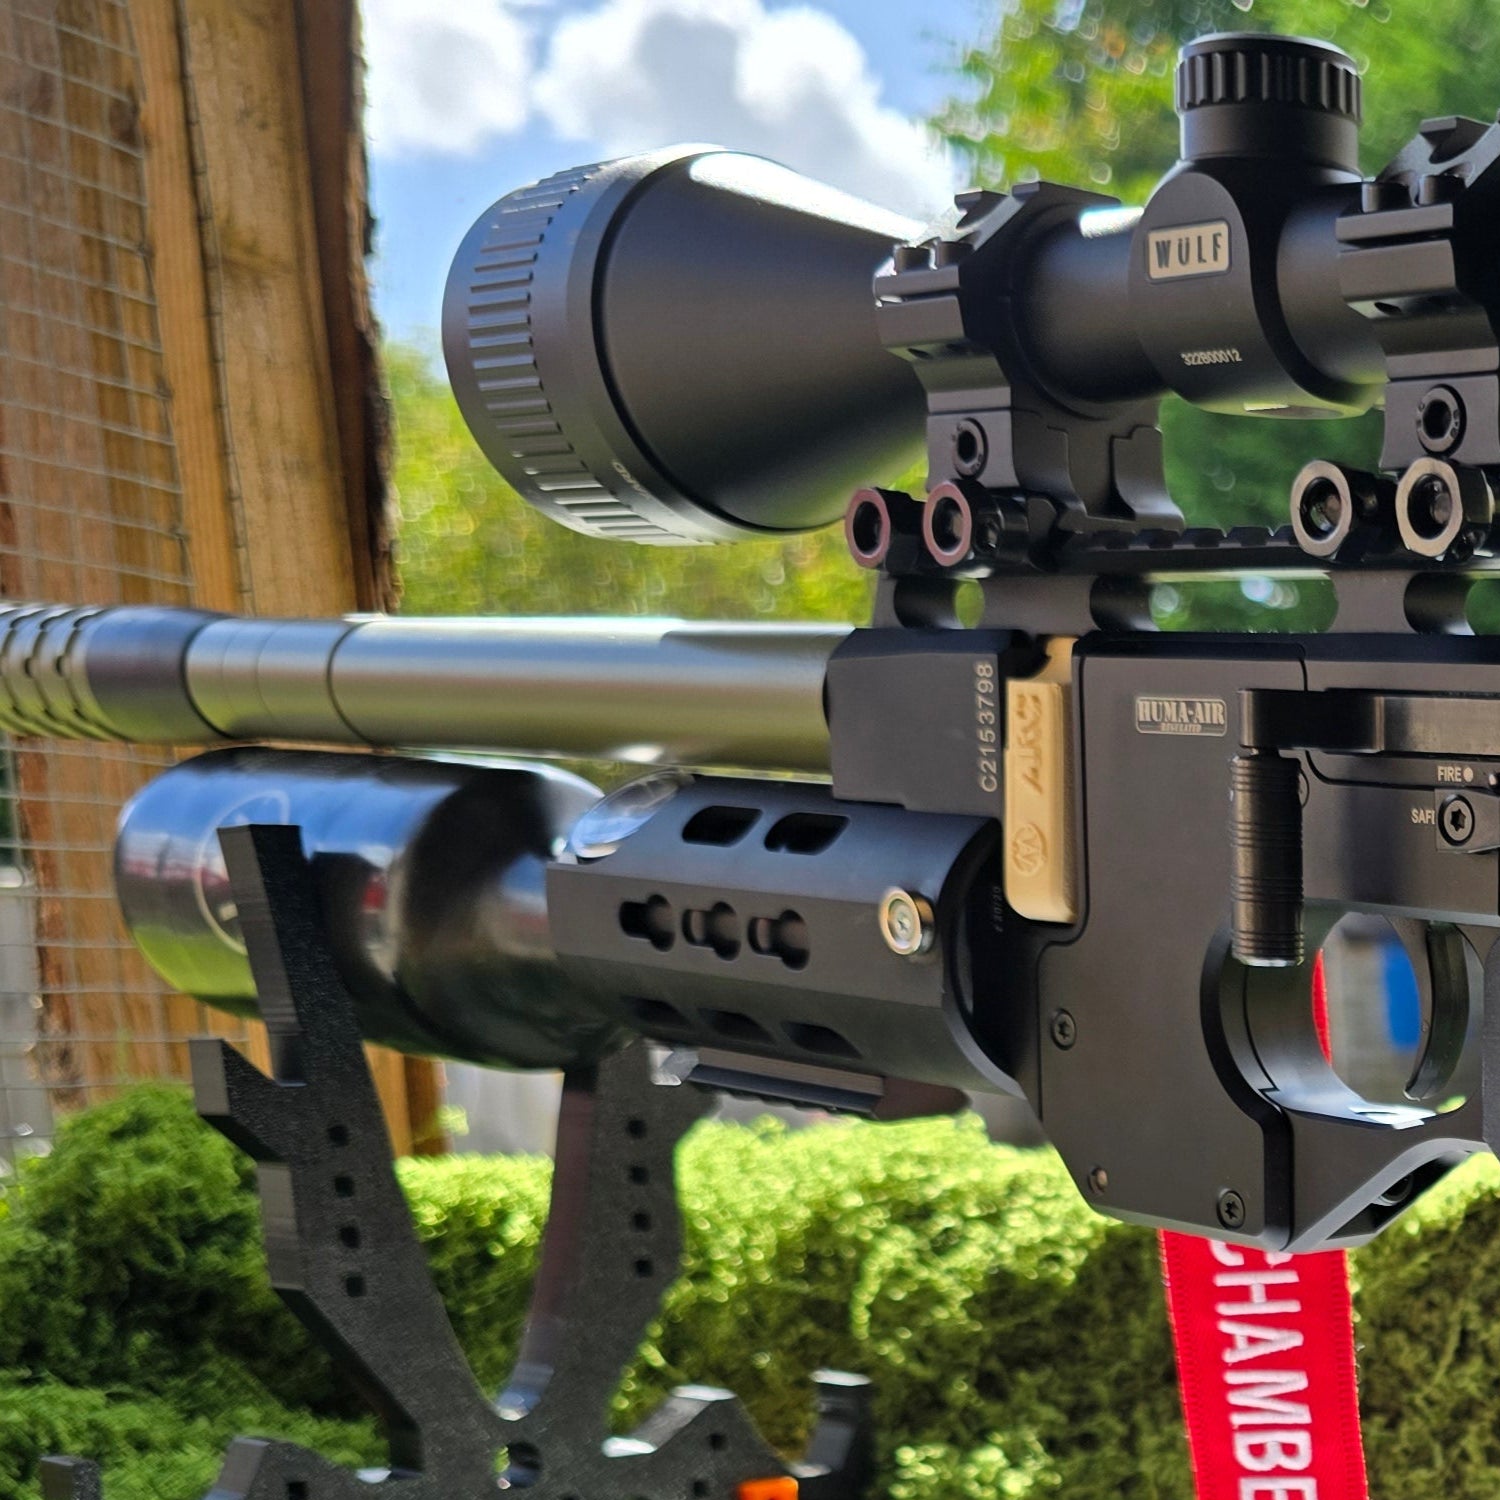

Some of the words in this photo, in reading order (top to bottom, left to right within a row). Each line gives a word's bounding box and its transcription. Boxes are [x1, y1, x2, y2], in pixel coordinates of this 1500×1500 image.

[1155, 232, 1222, 269] WÜLF
[974, 662, 999, 793] C2153798
[1437, 765, 1462, 782] FIRE
